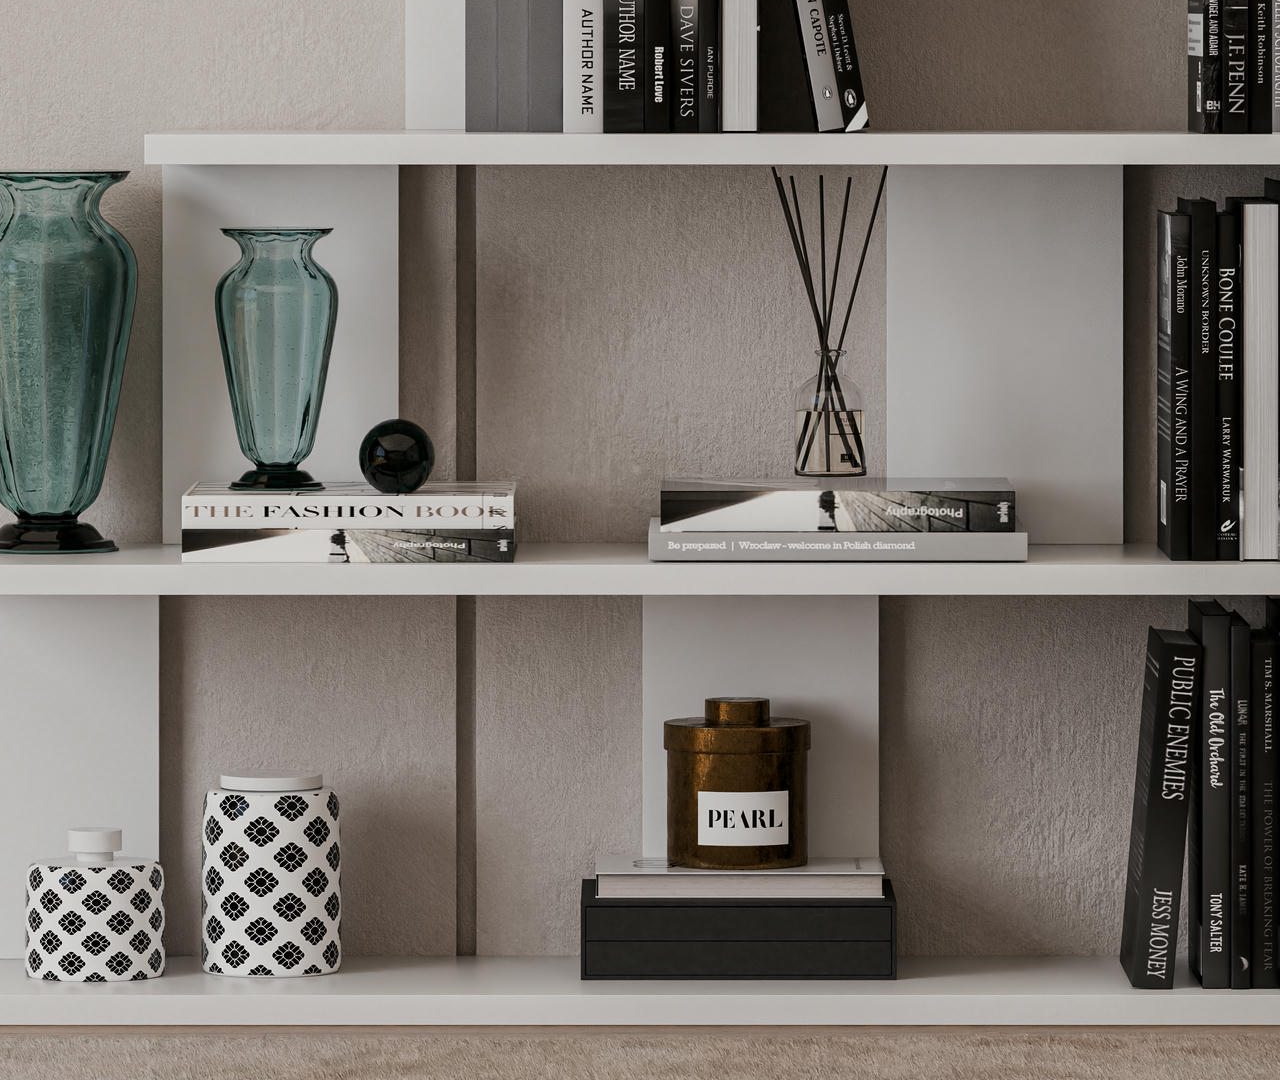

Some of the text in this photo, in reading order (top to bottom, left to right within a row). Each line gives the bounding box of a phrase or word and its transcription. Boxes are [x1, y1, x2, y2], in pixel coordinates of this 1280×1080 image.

[810, 8, 827, 56] CAPOTE
[1209, 24, 1219, 38] AND
[1209, 39, 1219, 56] ADAIR
[1258, 3, 1266, 84] Keith Robinson
[581, 9, 593, 115] AUTHOR NAME
[619, 49, 635, 90] NAME
[654, 46, 663, 102] Robert Love
[680, 6, 693, 117] DAVE SIVERS
[1224, 34, 1245, 113] J.F. PENN
[1177, 256, 1187, 313] John Morano
[1201, 250, 1209, 354] UNKNOWN BORDER
[1219, 268, 1235, 312] BONE
[1175, 367, 1188, 502] A WING AND A PRAYER
[1222, 418, 1231, 502] LARRY WARWARUK
[185, 506, 507, 518] THE FASHION BOOK
[886, 505, 963, 518] Photography
[393, 541, 465, 550] Photography
[668, 542, 680, 550] Be
[682, 542, 726, 552] prepared
[788, 542, 831, 550] welcome
[832, 542, 842, 550] in
[843, 542, 871, 550] Polish
[873, 542, 915, 550] diamond
[1162, 656, 1195, 800] PUBLIC ENEMIES
[1237, 699, 1248, 726] LUNAR
[1264, 657, 1273, 753] TIM S. MARSHALL
[1210, 689, 1224, 788] The Old Orchard
[708, 809, 783, 829] PEARL
[1264, 779, 1272, 972] THE POWER OF BREAKING FEAR
[1146, 888, 1172, 979] JESS MONEY
[1210, 893, 1222, 953] TONY SALTER
